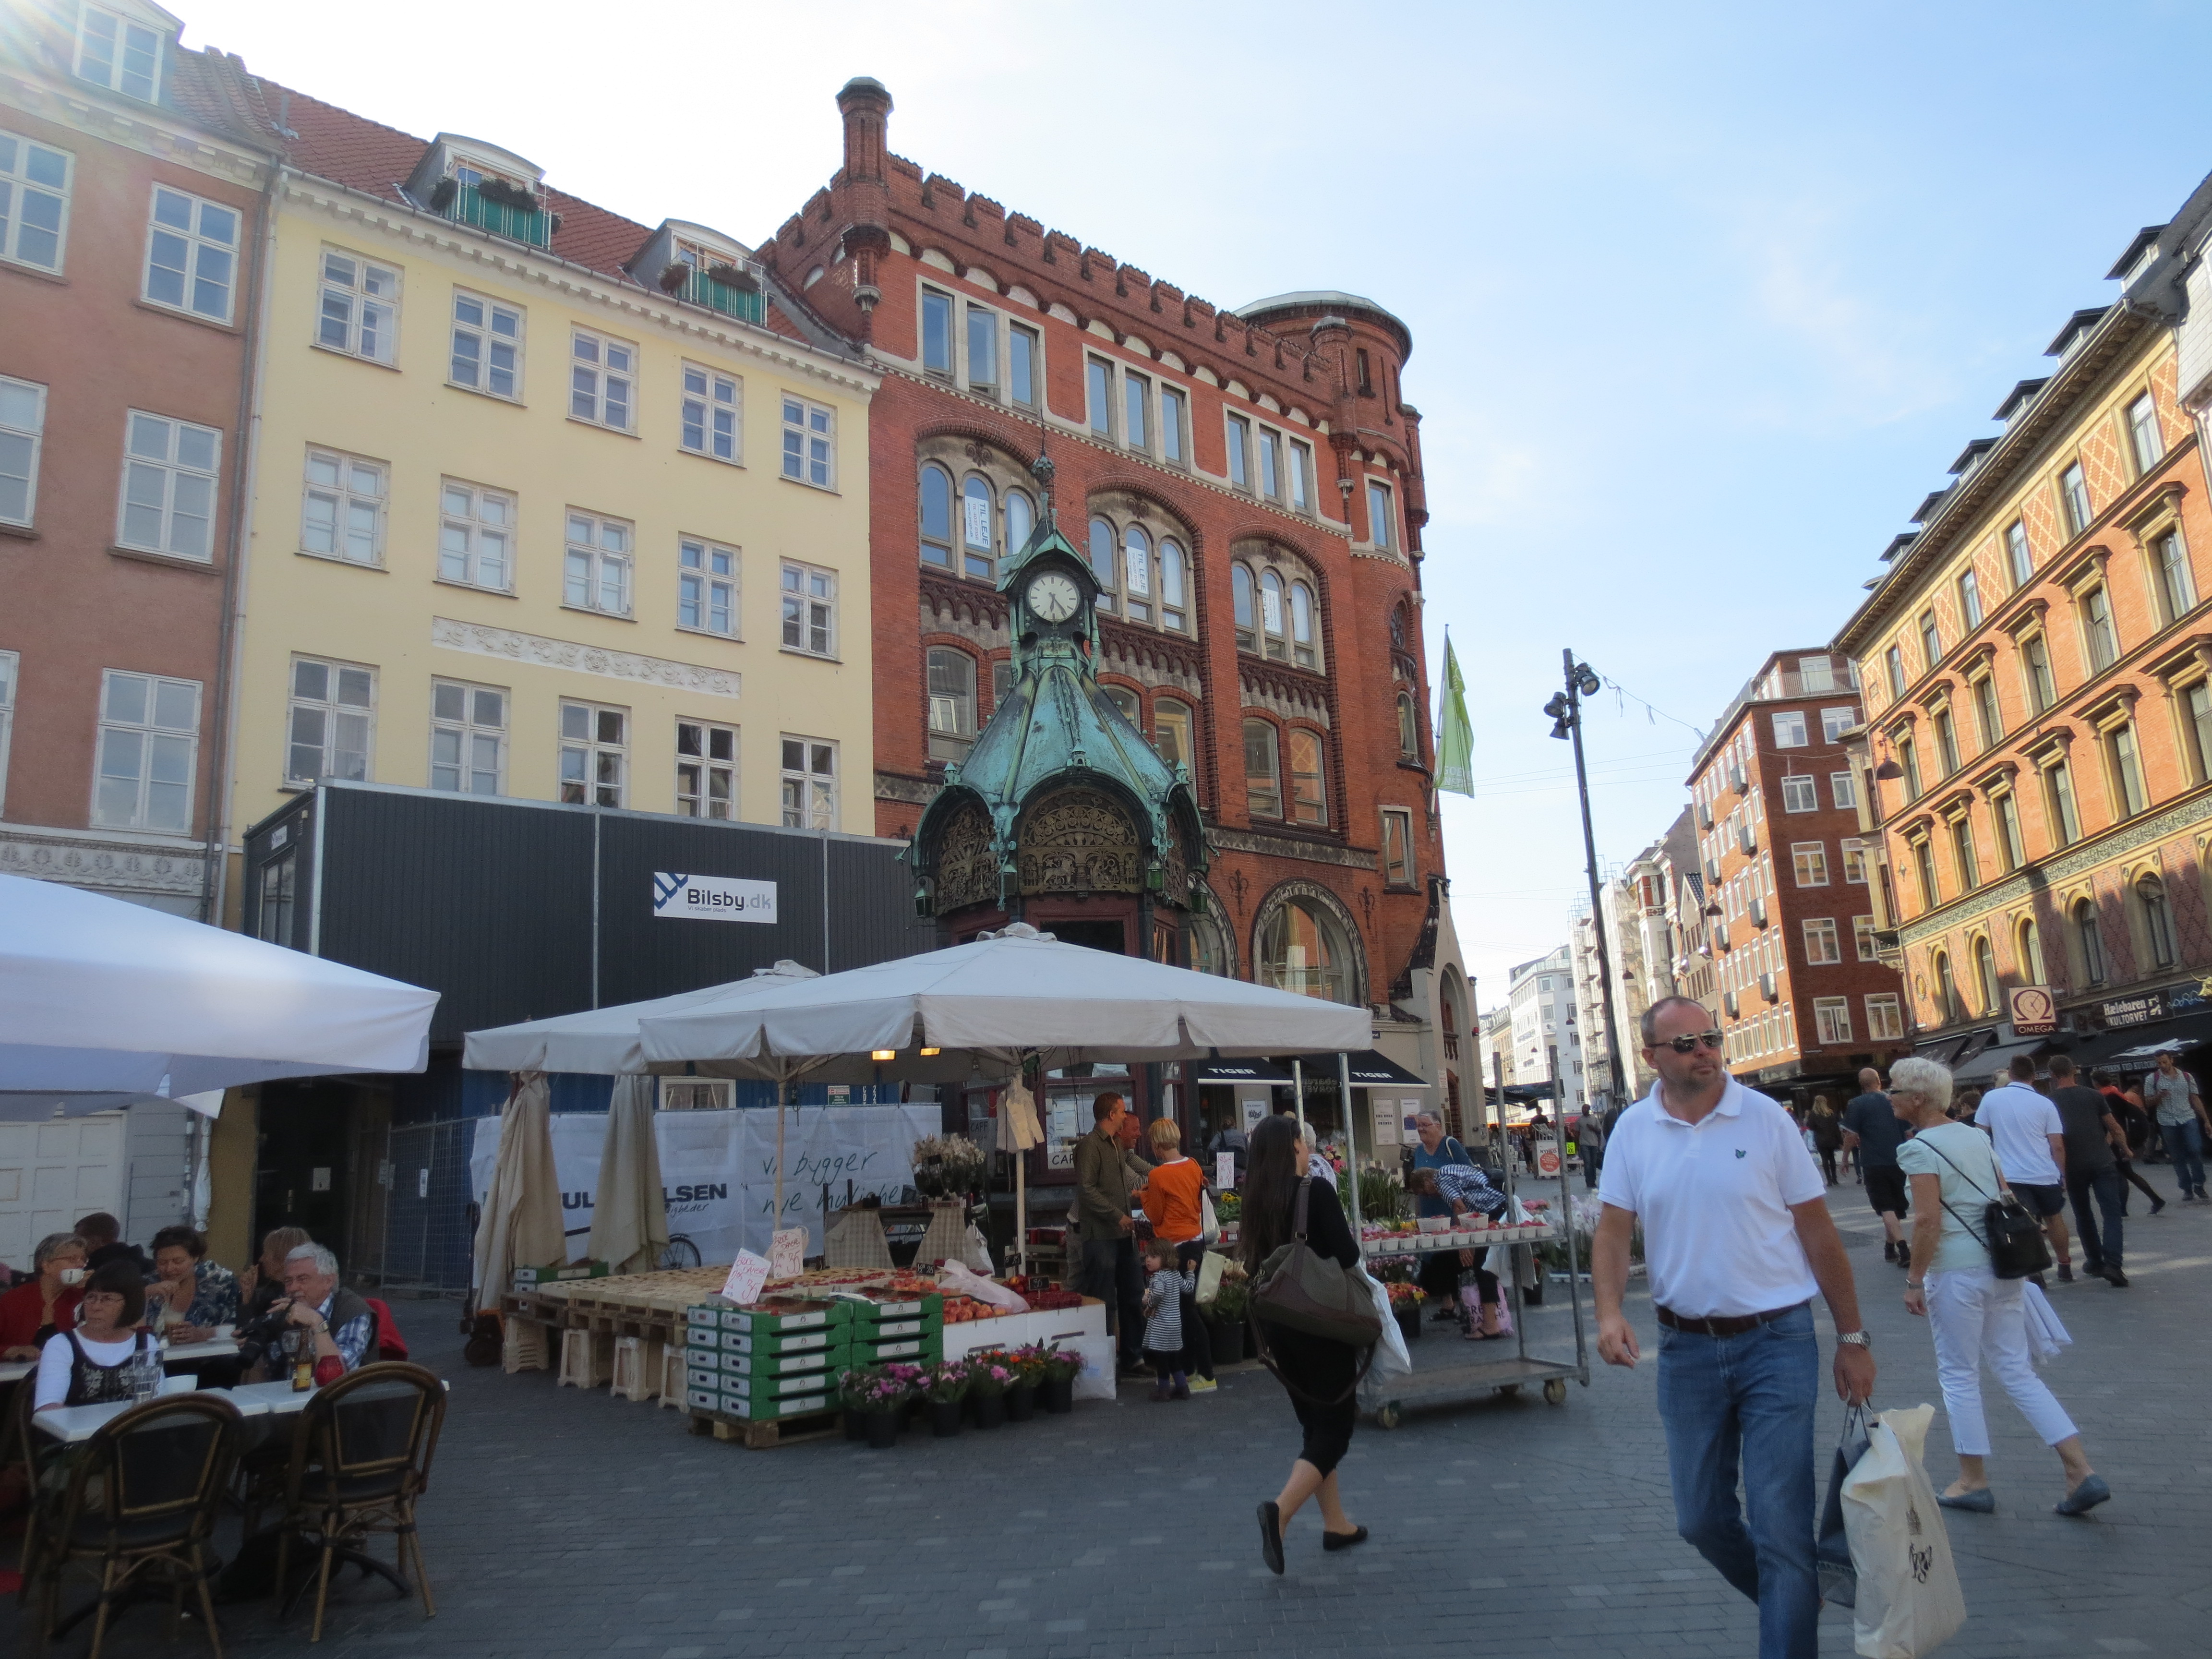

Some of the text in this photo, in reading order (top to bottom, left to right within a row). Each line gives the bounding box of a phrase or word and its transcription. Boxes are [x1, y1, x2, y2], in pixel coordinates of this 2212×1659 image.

[687, 889, 771, 911] Bilsby.dk
[2103, 999, 2146, 1016] Hælebaren
[2107, 1010, 2147, 1026] KULTORVET
[2019, 1025, 2055, 1034] OMEGA
[794, 1151, 878, 1186] bygger
[1052, 1154, 1075, 1166] CAF
[559, 1183, 727, 1210] UL LSEN
